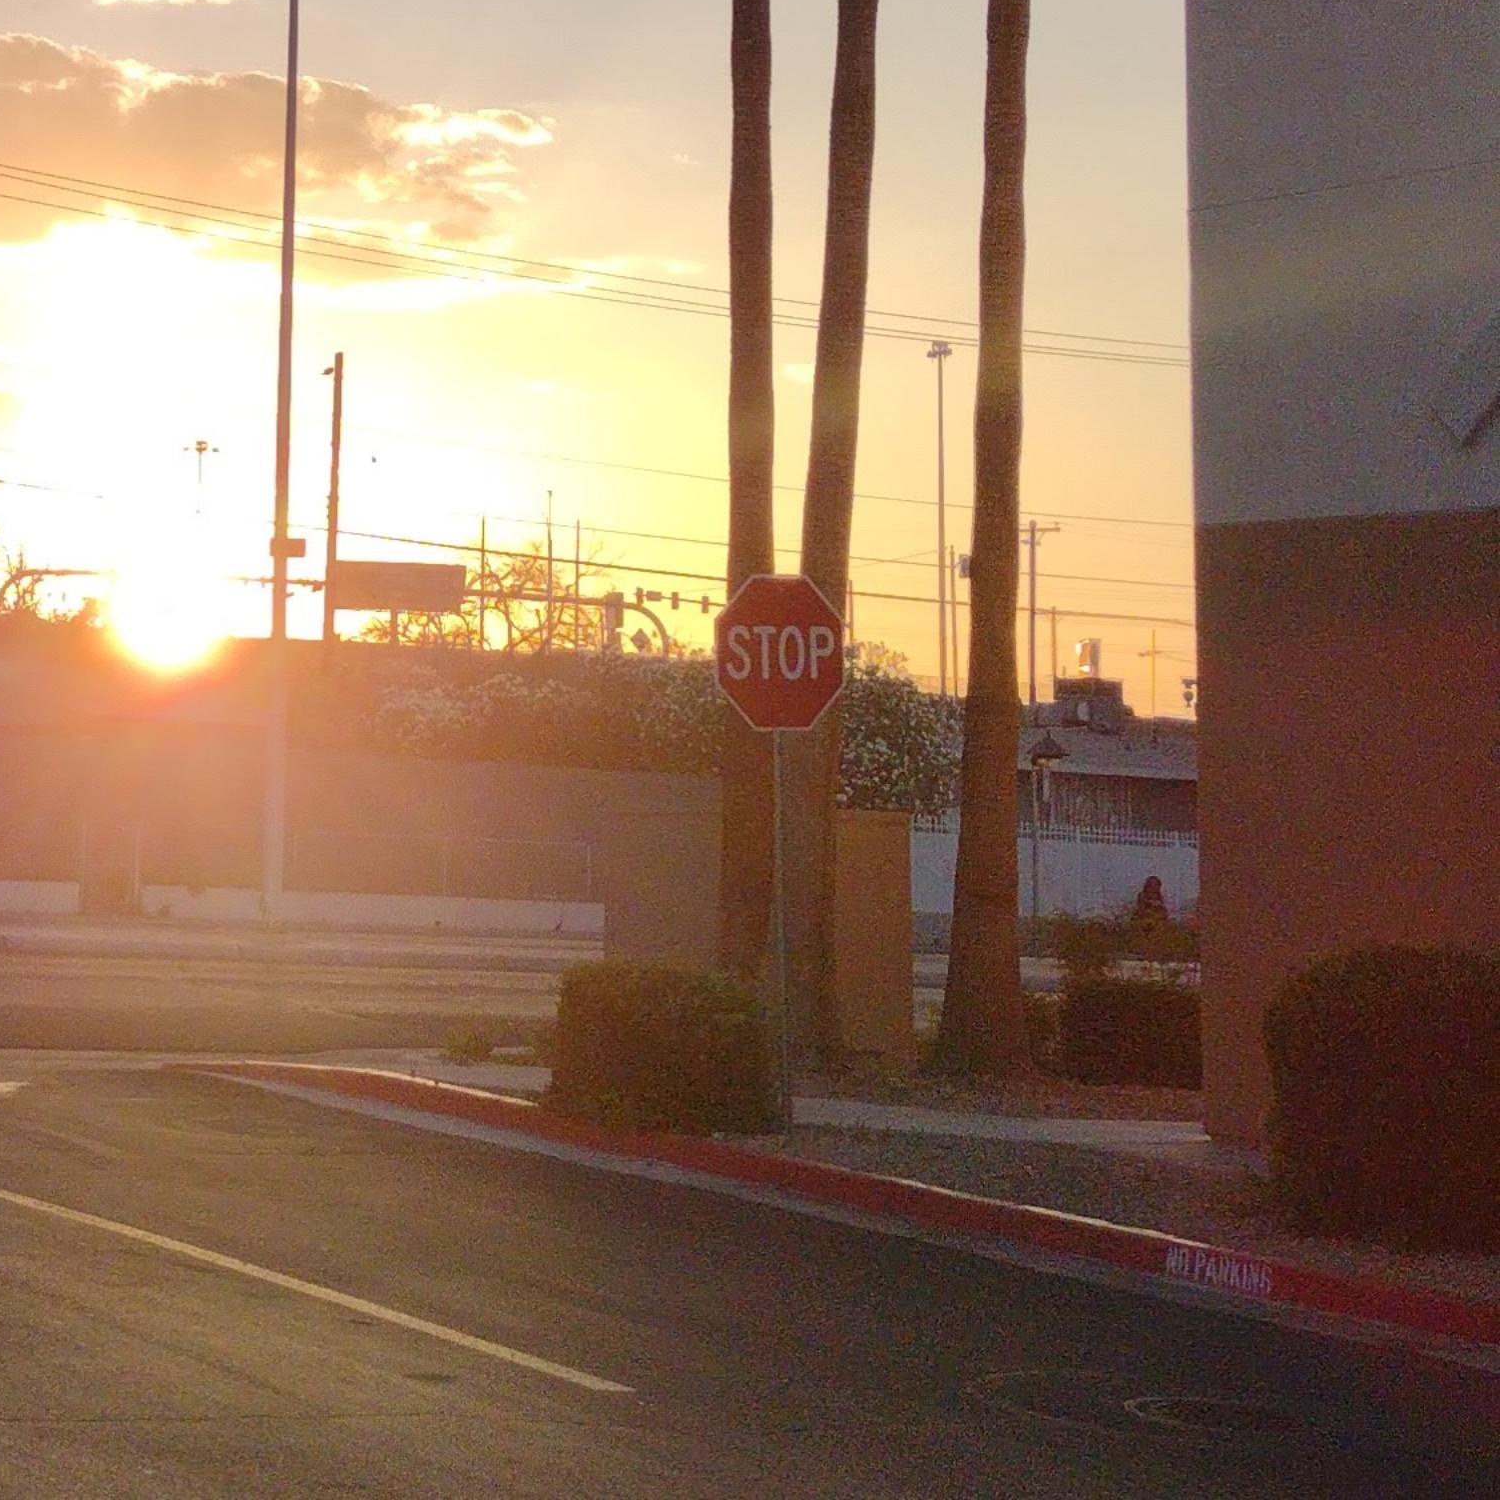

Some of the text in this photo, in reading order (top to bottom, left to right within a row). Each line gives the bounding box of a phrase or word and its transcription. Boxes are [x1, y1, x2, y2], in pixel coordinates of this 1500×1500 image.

[725, 624, 835, 680] STOP
[1165, 1244, 1273, 1294] NO PARKING
